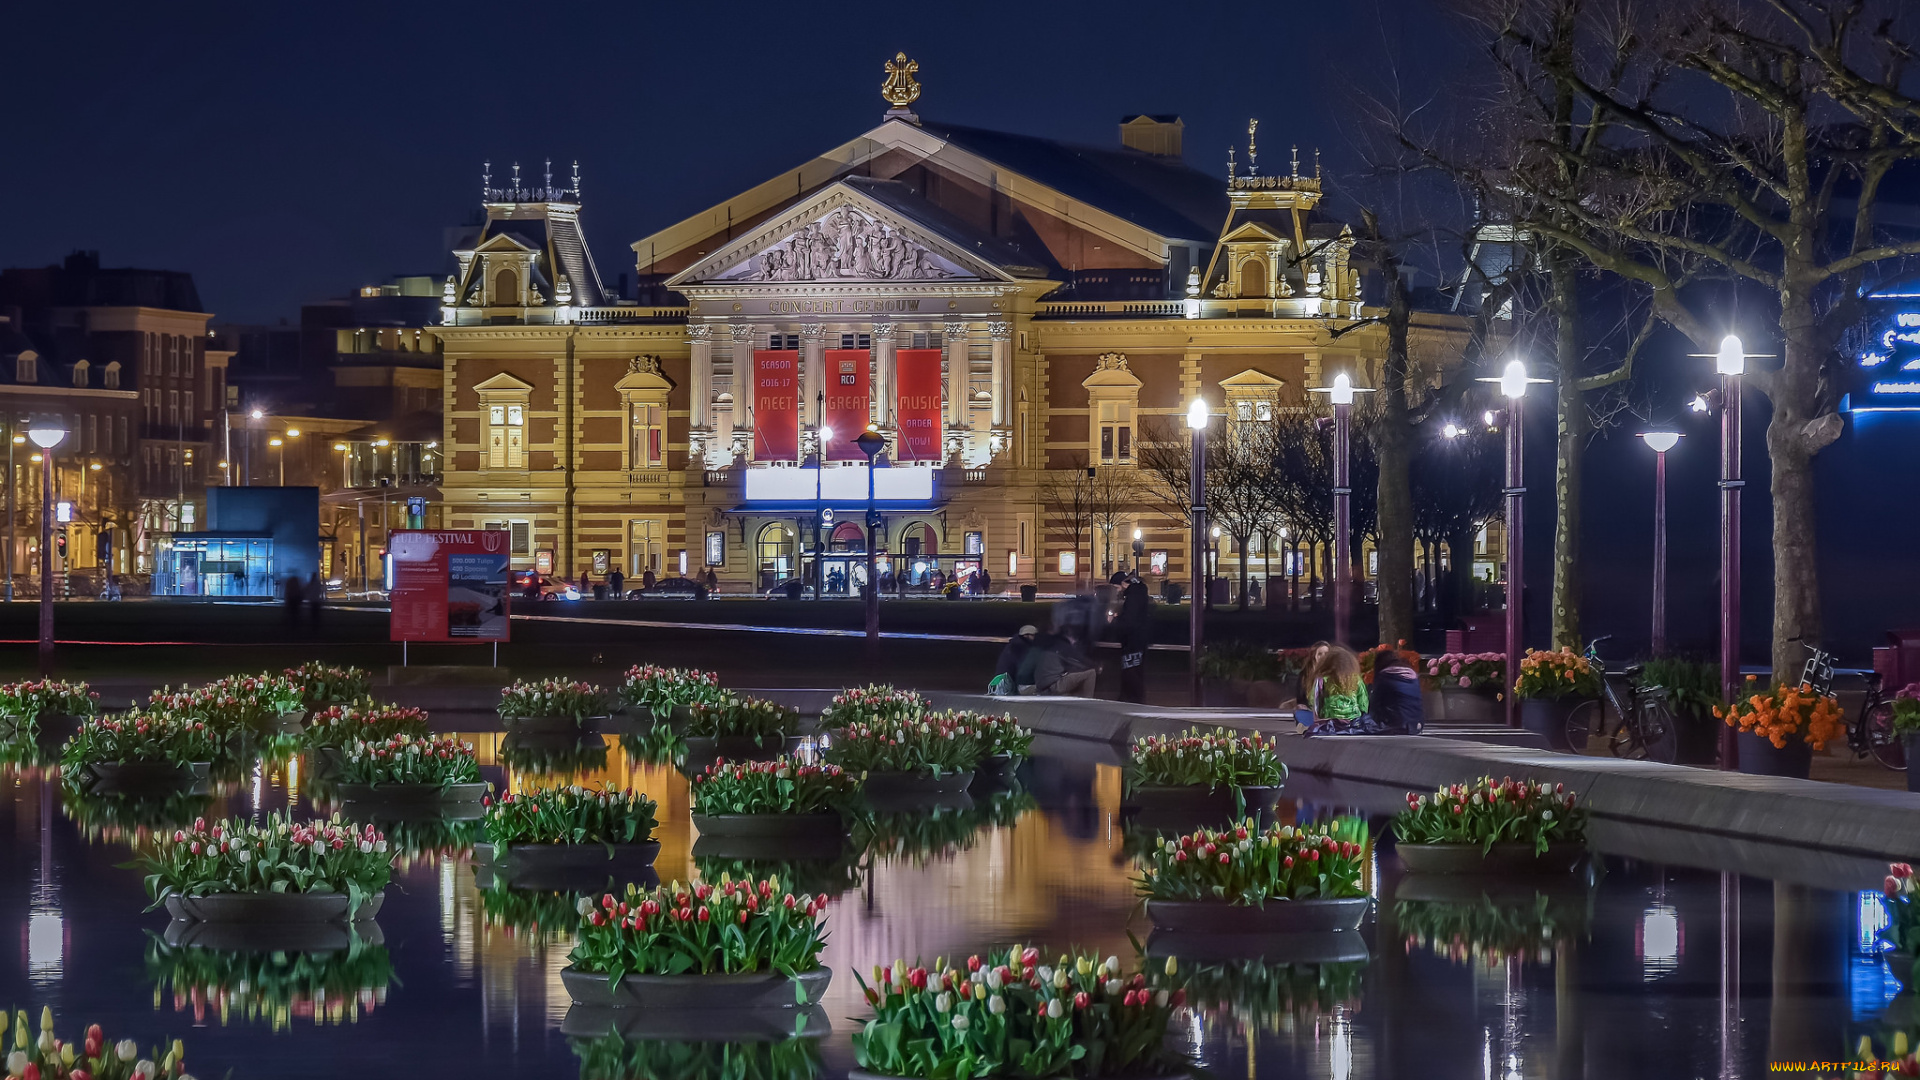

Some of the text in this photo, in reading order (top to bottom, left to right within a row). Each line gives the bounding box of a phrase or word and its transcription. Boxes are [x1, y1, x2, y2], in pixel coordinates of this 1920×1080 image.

[760, 360, 791, 370] SEASON
[840, 375, 855, 385] RCO
[760, 396, 793, 411] MEET
[828, 396, 868, 410] GREAT
[900, 396, 940, 410] MUSIC
[906, 419, 932, 428] ORDER
[395, 533, 475, 544] TULP FESTIVAL
[477, 557, 494, 565] Tulips
